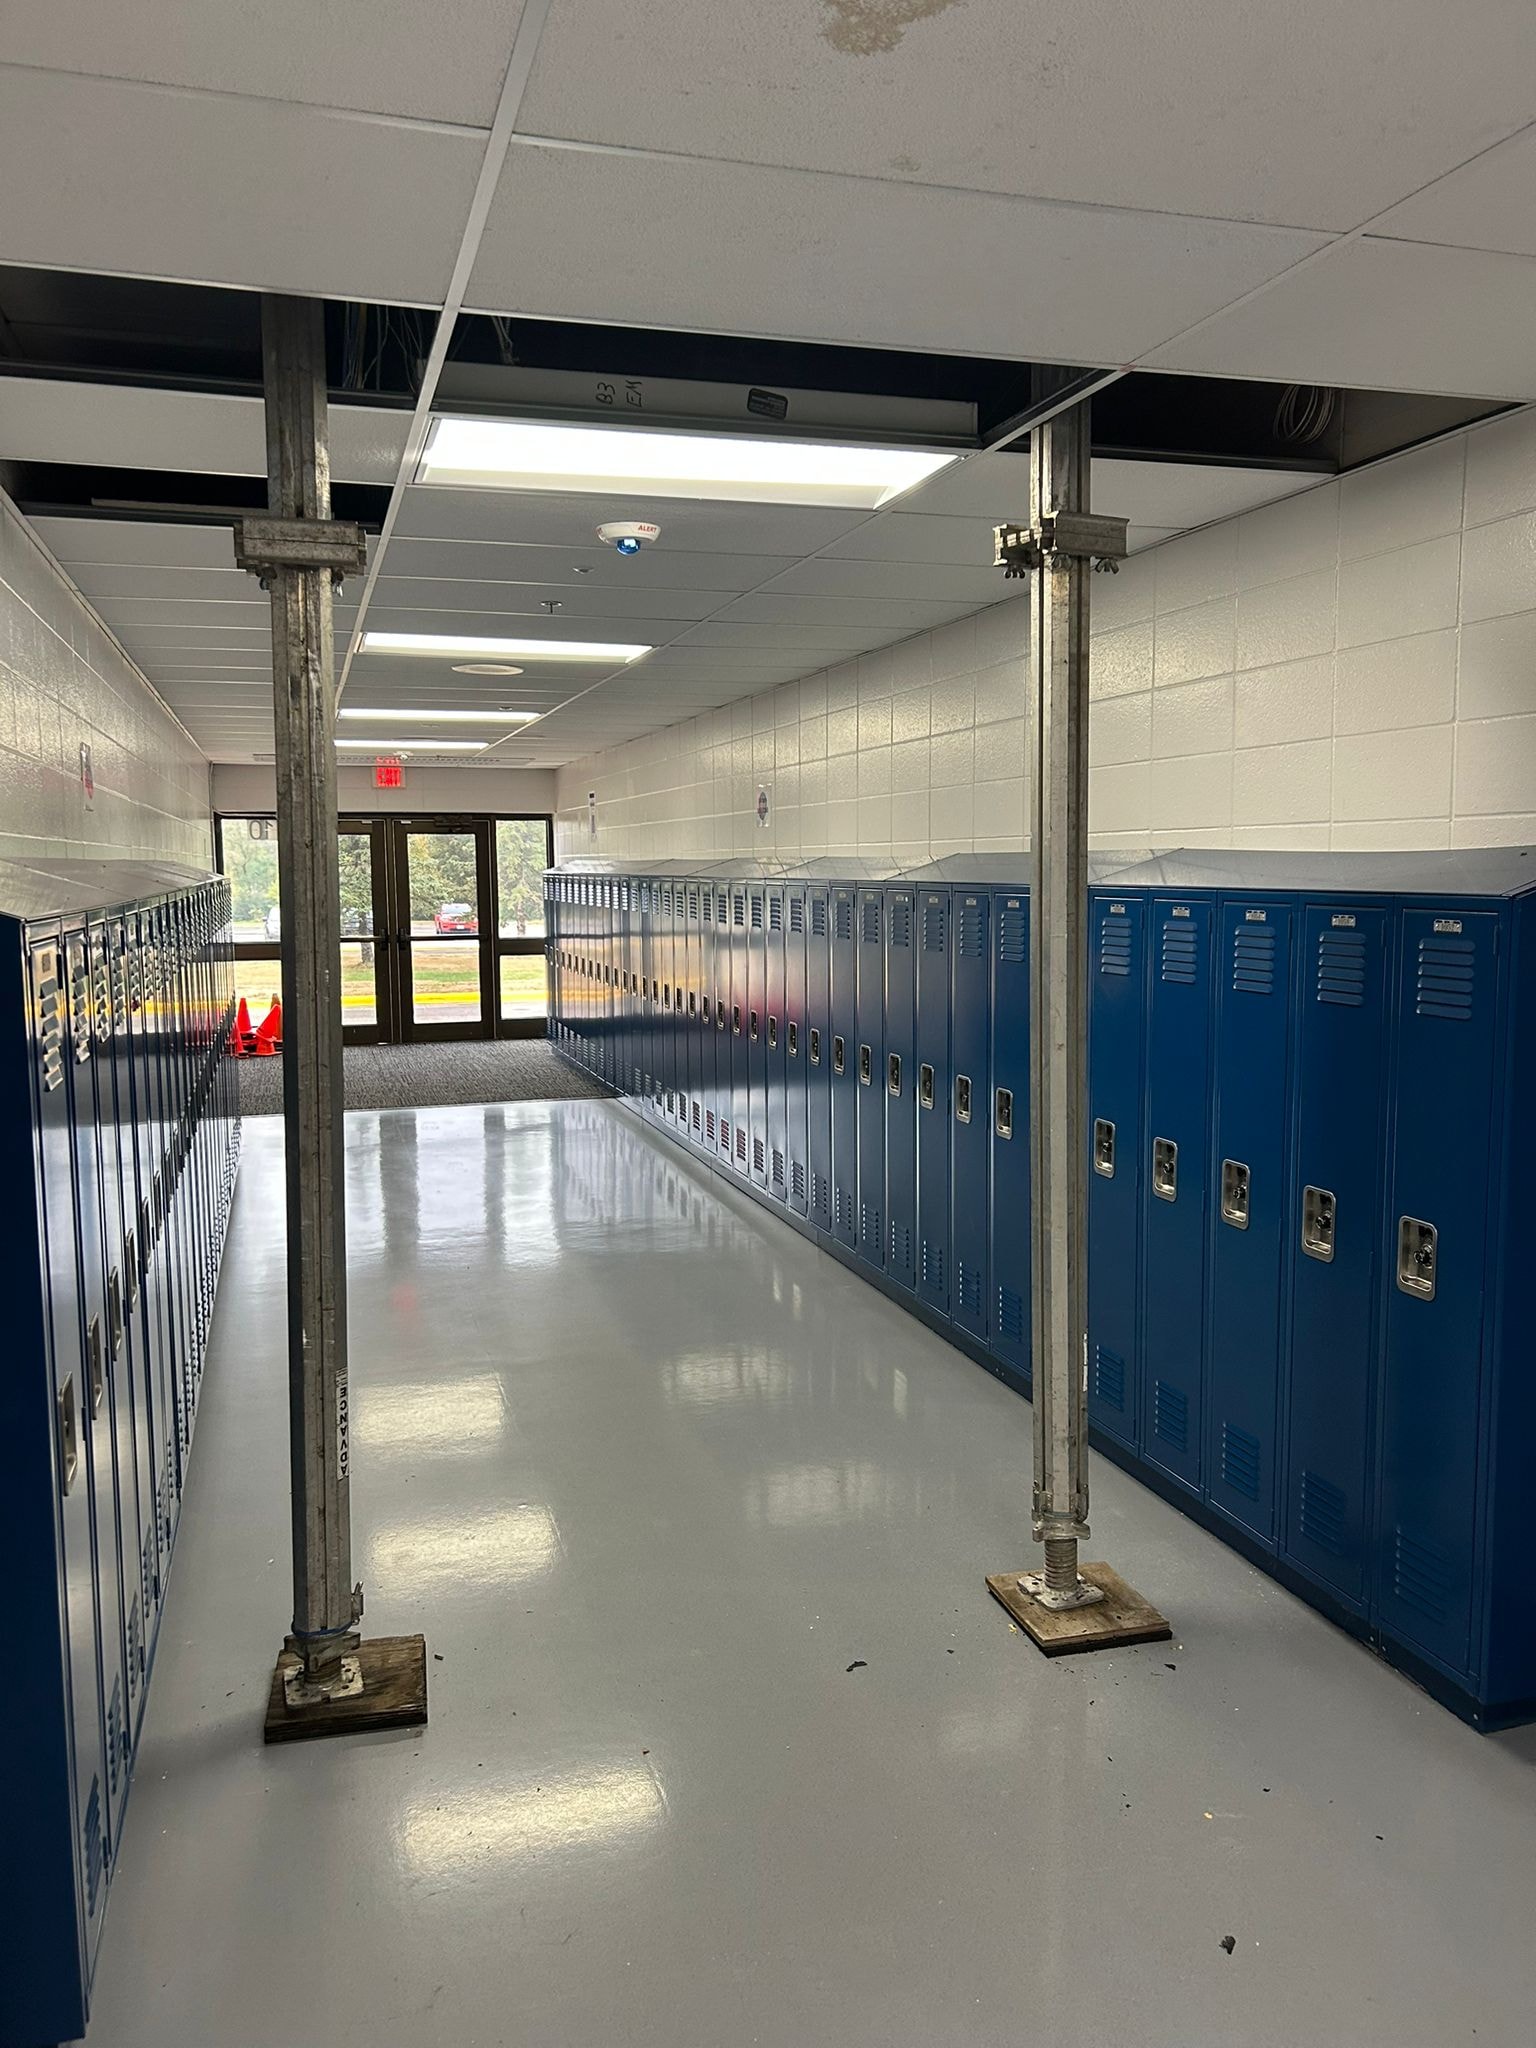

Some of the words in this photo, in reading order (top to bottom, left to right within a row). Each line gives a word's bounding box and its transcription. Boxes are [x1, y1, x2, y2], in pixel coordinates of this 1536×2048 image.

[638, 525, 657, 533] ALERT
[377, 768, 402, 787] EXIT
[339, 1387, 348, 1475] ADVANCE
